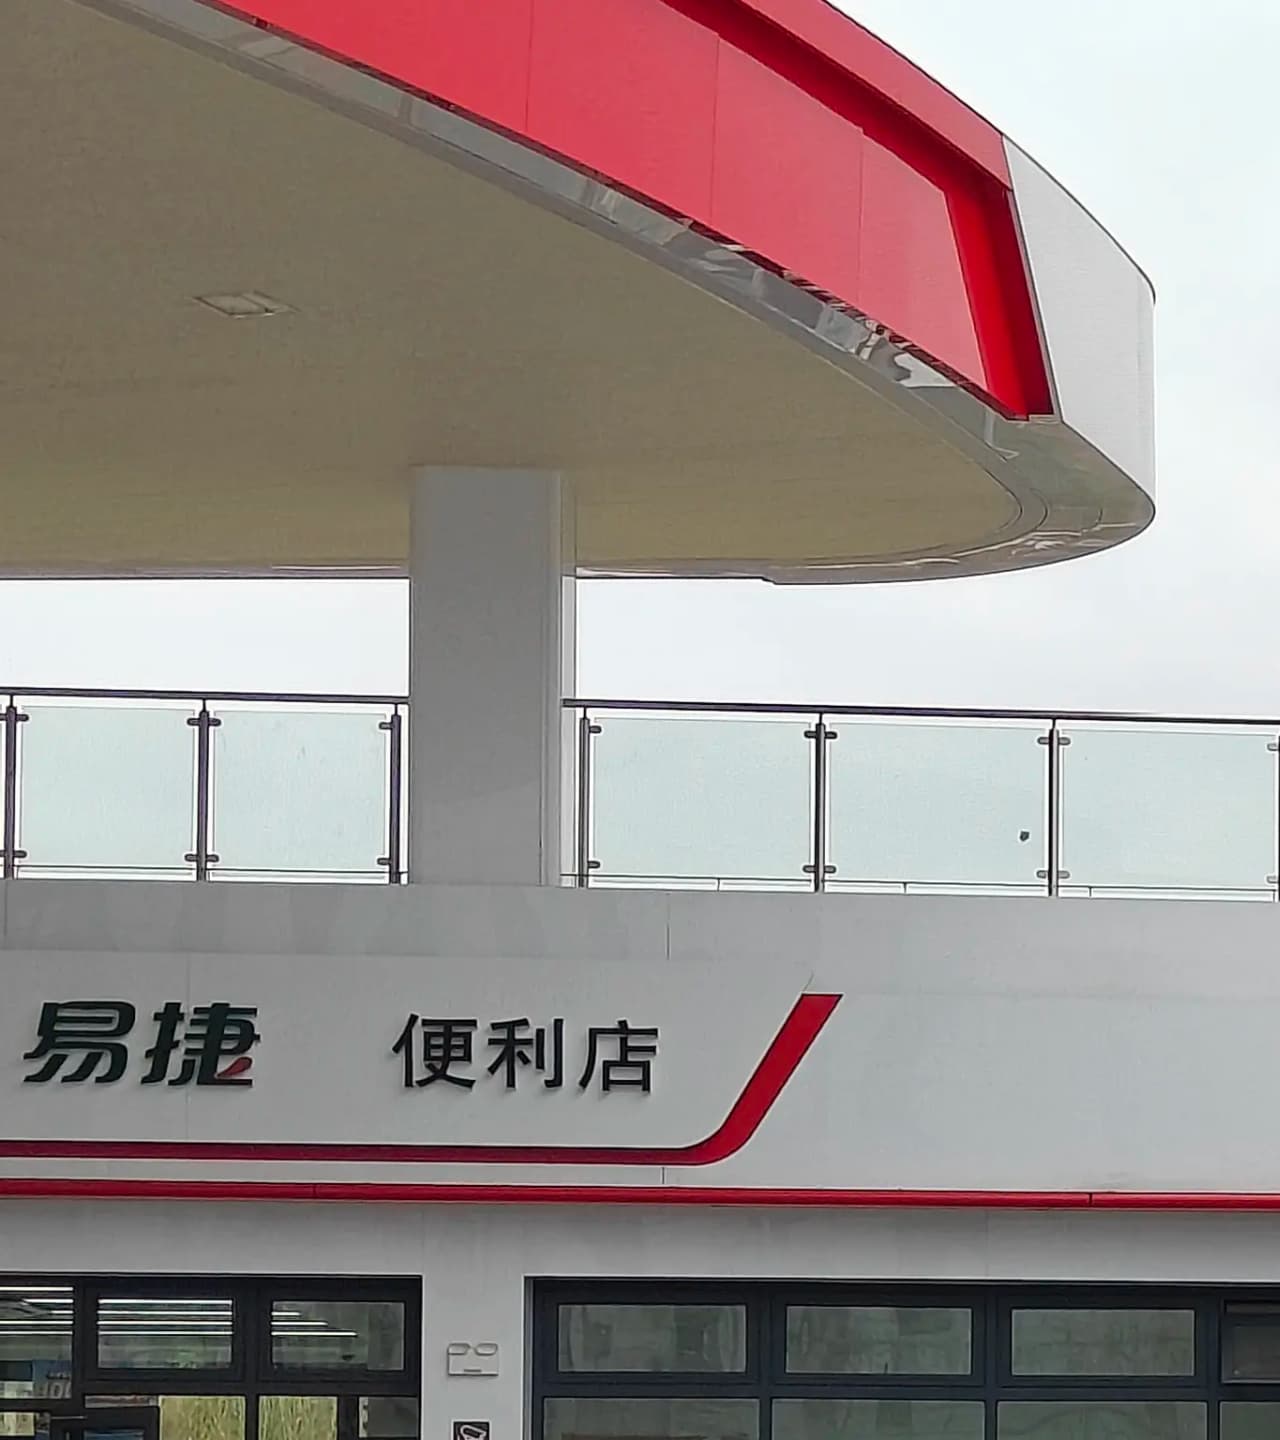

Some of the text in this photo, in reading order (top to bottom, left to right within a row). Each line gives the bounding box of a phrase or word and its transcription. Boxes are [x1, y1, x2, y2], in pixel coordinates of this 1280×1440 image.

[23, 1001, 260, 1087] 易捷
[393, 1014, 659, 1092] 便利店
